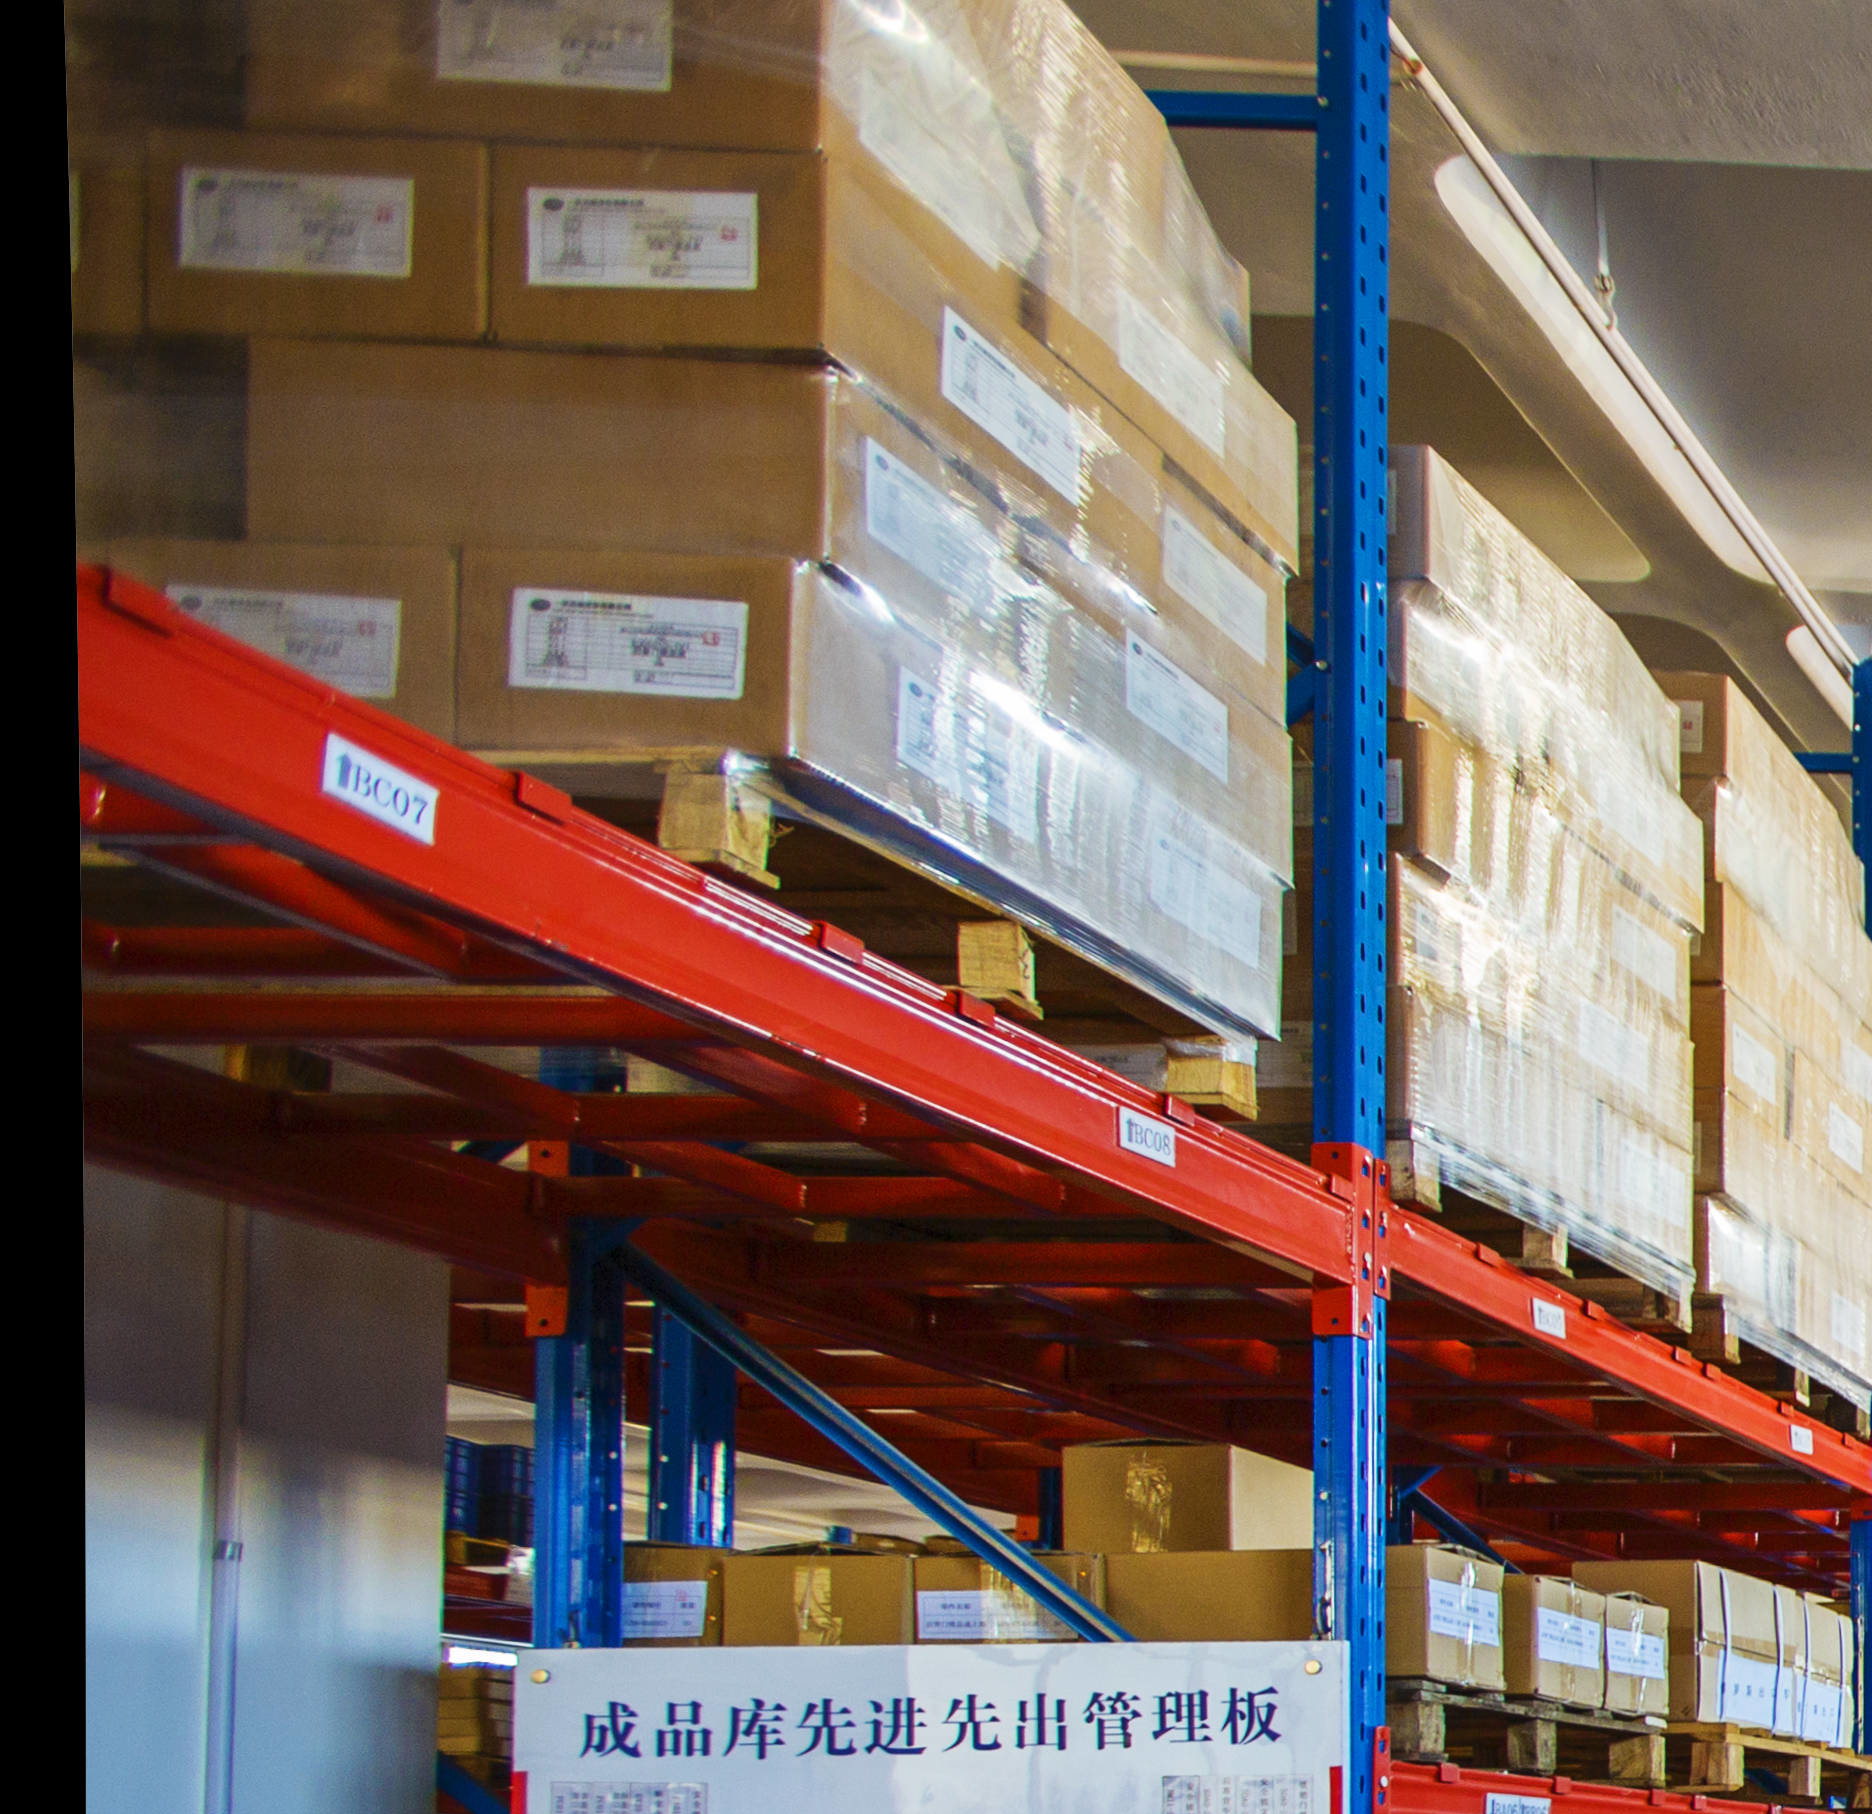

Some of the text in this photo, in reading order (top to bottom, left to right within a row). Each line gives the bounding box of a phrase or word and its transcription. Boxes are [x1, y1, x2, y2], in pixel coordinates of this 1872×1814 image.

[353, 764, 428, 825] BC07
[1134, 1122, 1171, 1156] BC08
[578, 1685, 1284, 1760] 成品库先进先出管理板
